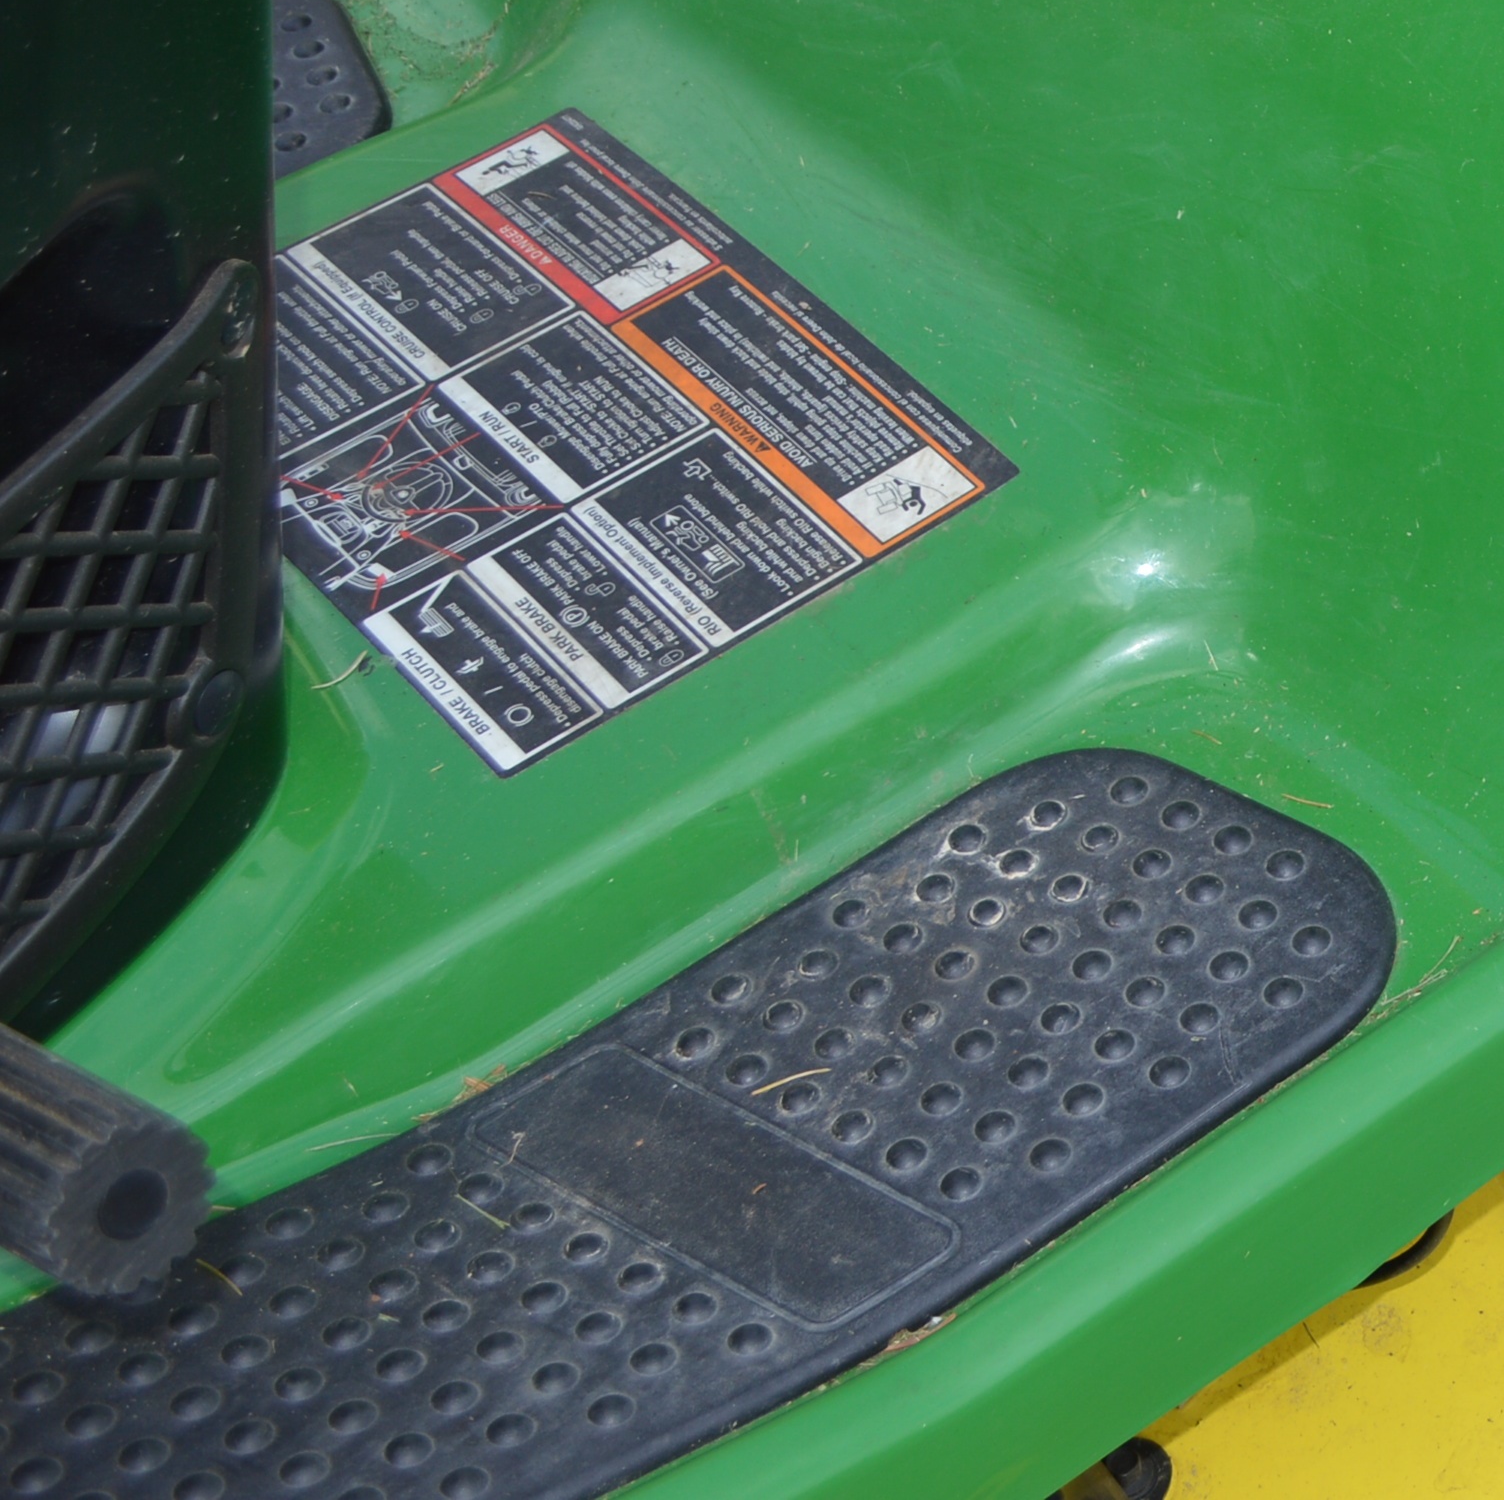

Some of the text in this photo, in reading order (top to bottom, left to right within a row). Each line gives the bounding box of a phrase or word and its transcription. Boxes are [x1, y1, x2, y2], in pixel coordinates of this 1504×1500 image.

[498, 224, 543, 259] DANGER
[311, 260, 425, 358] CRUISE CONTROL (If Equipped)
[426, 298, 467, 331] CRUISE ON
[473, 268, 519, 304] CRUISE OFF
[661, 337, 813, 467] AVOID SERIOUS INJURY OR DEATH
[709, 401, 758, 445] WARNING
[478, 410, 539, 463] START / RUN
[701, 474, 817, 576] Depress and hold RIO switch...
[722, 450, 843, 561] Release RIO switch while backing
[545, 538, 592, 580] brake pedal
[555, 525, 606, 572] Lower handle
[582, 505, 722, 636] RIO (Reverse Implement Option)
[626, 516, 718, 600] (See Owner's Manual)
[683, 493, 790, 592] Look down and behind before
[735, 520, 803, 582] and while backing
[775, 517, 830, 569] Begin backing
[511, 548, 574, 605] PARK BRAKE OFF
[545, 556, 578, 588] Depress
[514, 596, 584, 661] PARK BRAKE
[615, 625, 650, 658] Depress
[616, 606, 664, 650] brake pedal
[627, 594, 677, 642] Raise handle
[444, 601, 568, 723] Depress pedal to engage brake and
[586, 619, 648, 678] PARK BRAKE ON
[400, 647, 490, 735] BRAKE / CLUTCH
[519, 652, 581, 713] disengage clutch
